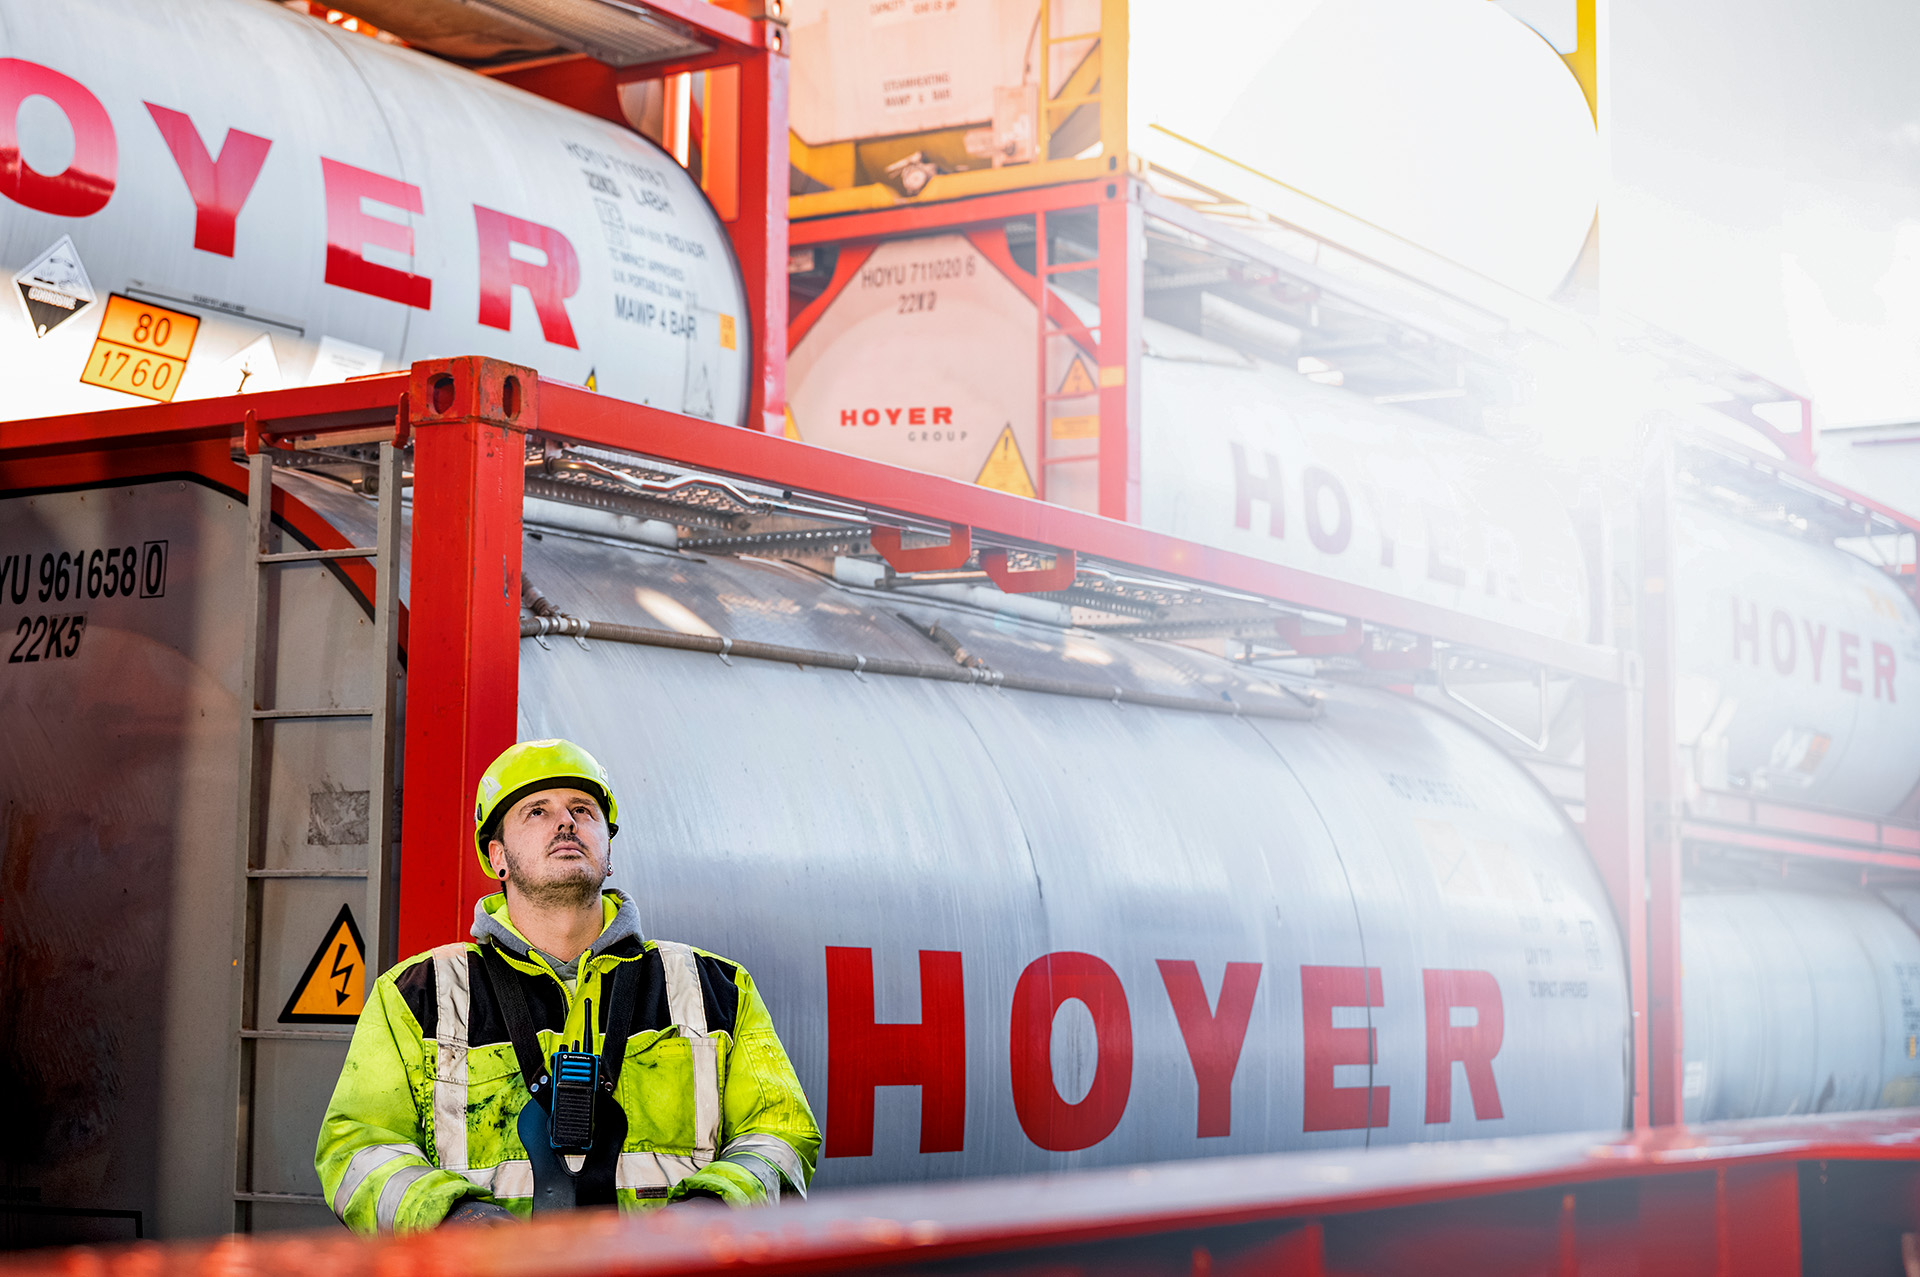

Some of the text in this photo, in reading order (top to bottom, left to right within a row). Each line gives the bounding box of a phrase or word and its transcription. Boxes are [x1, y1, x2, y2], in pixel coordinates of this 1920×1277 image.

[861, 263, 906, 289] HOYU
[133, 313, 171, 347] 80
[614, 292, 656, 328] MAWP
[669, 310, 698, 340] BAR
[98, 350, 172, 391] 1760
[840, 406, 953, 427] HOYER
[908, 430, 967, 442] GROUP
[38, 546, 137, 603] 961658
[144, 542, 164, 596] 0
[8, 615, 84, 664] 22K5
[1731, 594, 1897, 703] HOYER
[825, 946, 1505, 1158] HOYER
